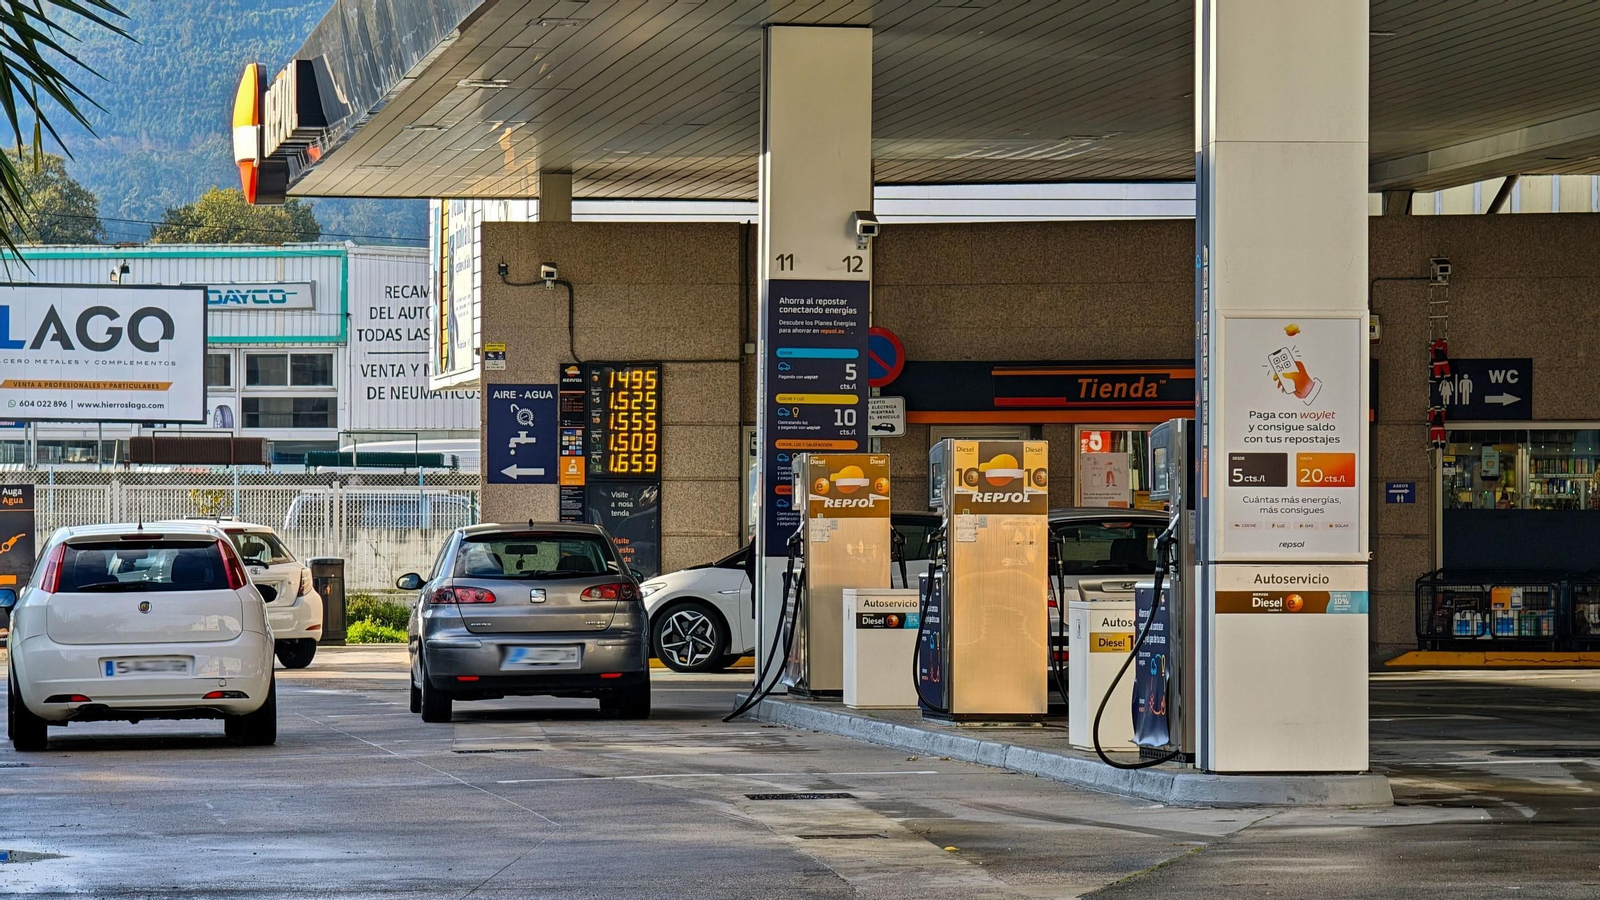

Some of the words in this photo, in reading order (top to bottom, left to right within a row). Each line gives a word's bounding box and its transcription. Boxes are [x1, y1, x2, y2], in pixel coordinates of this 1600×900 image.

[776, 254, 793, 270] 11
[842, 256, 863, 272] 12
[207, 288, 293, 304] DAYCO
[370, 307, 394, 319] DEL
[825, 307, 857, 316] energías
[357, 329, 402, 342] TODAS
[407, 328, 430, 341] LAS
[361, 364, 405, 378] VENTA
[410, 364, 420, 376] Y
[845, 364, 857, 380] 5
[1488, 370, 1518, 383] WC
[367, 387, 386, 399] DE
[1078, 377, 1157, 398] Tienda
[493, 390, 516, 399] AIRE
[524, 390, 553, 399] AGUA
[77, 401, 164, 410] www.hierroslago.com
[610, 392, 656, 410] 1.525
[610, 412, 656, 430] 1.555
[834, 409, 856, 426] 10
[1250, 411, 1276, 421] Paga
[1300, 410, 1335, 421] waylet
[1257, 424, 1304, 433] consigue
[1307, 423, 1335, 431] saldo
[610, 433, 656, 451] 1.509
[1285, 435, 1340, 445] repostajes
[610, 454, 656, 472] 1.659
[1232, 468, 1243, 483] 5
[1244, 474, 1265, 483] cts./l
[1300, 468, 1323, 483] 20
[1325, 474, 1345, 483] cts./l
[2, 487, 22, 496] Auga
[972, 492, 1030, 503] REPSOL
[2, 497, 24, 506] Agua
[824, 499, 875, 507] REPSOL
[1243, 495, 1279, 504] Cuántas
[1301, 496, 1341, 505] energías,
[1280, 507, 1324, 515] consigues
[1254, 574, 1329, 584] Autoservicio
[1252, 598, 1282, 607] Diesel
[1099, 638, 1125, 646] Diesel
[1128, 635, 1134, 650] 1
